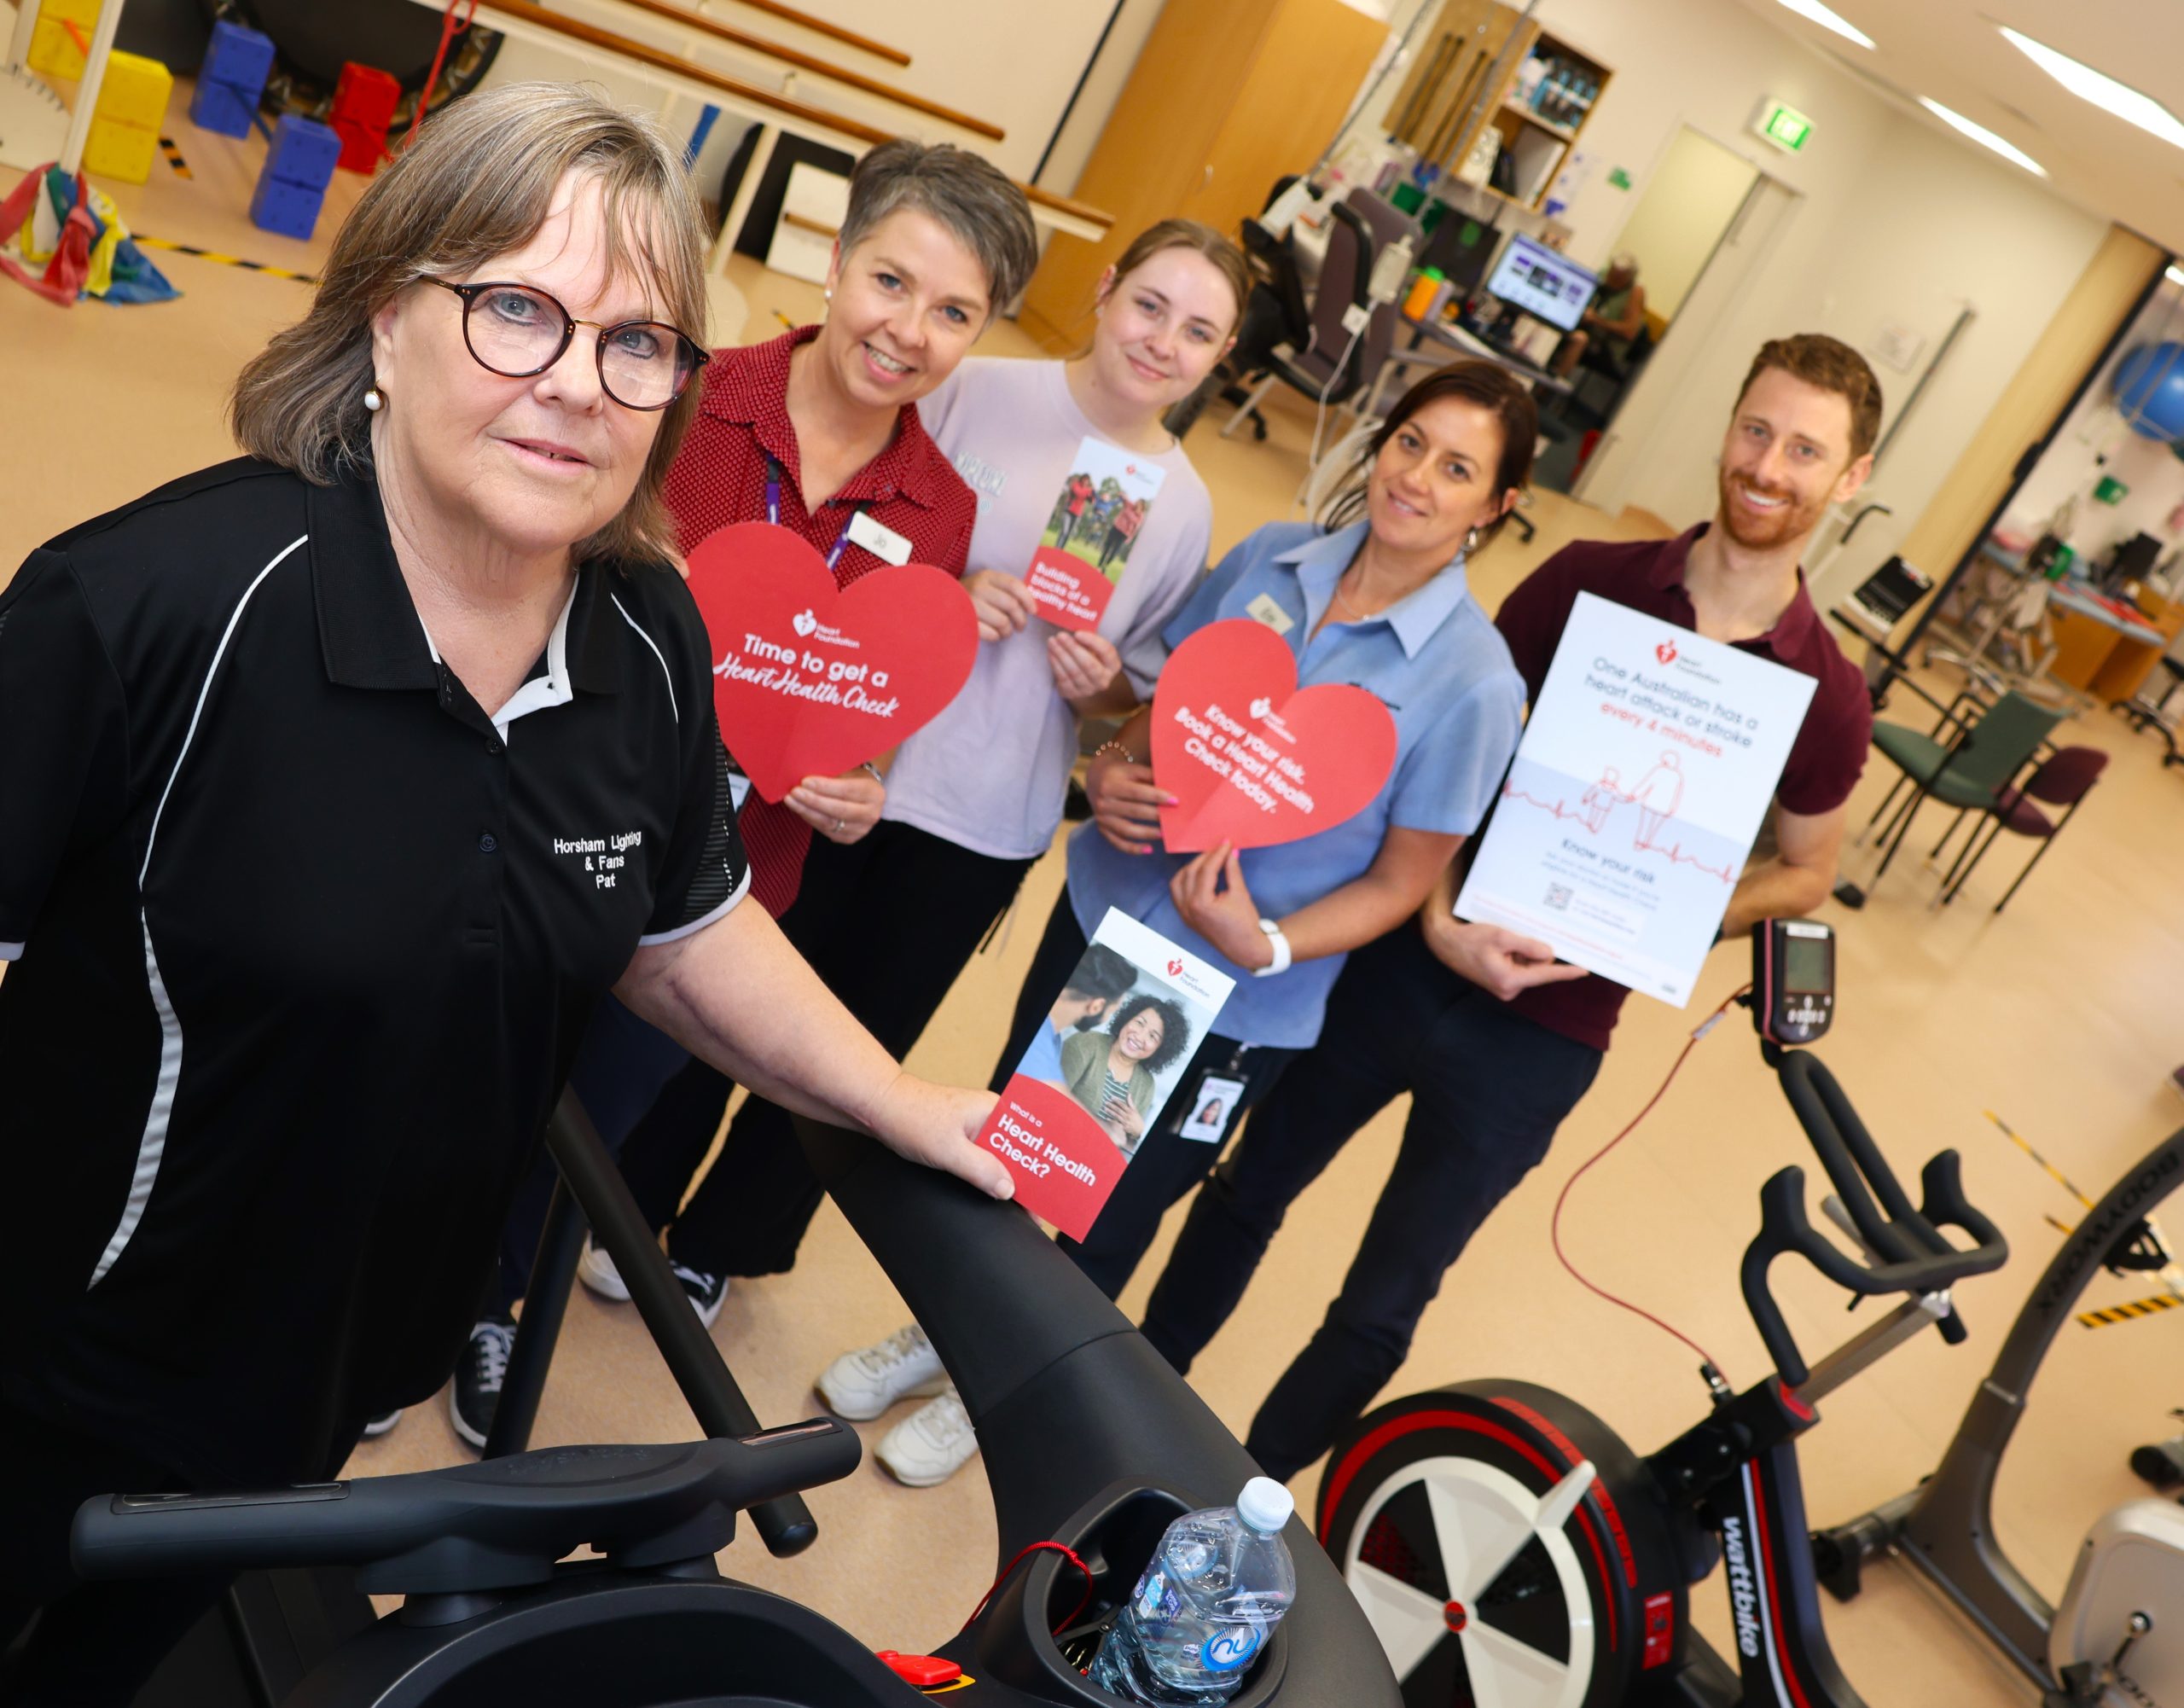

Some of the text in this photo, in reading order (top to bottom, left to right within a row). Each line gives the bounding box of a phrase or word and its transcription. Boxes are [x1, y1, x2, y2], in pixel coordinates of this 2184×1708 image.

[1036, 561, 1079, 590] Building
[713, 652, 900, 717] Heart Health Check
[745, 633, 889, 688] Time to get a
[1584, 672, 1753, 748] heart attack or stroke
[1593, 656, 1759, 730] One Australian has a
[1205, 704, 1247, 739] Know
[1242, 731, 1280, 763] your
[1275, 756, 1306, 785] risk.
[1600, 702, 1644, 729] every
[1660, 723, 1722, 758] minutes
[1174, 706, 1315, 814] Book a Heart Health
[1184, 736, 1278, 814] Check today.
[554, 830, 642, 854] Horsham Lighting
[584, 855, 624, 871] & Fans
[1561, 837, 1598, 860] Know
[1600, 851, 1630, 874] your
[1632, 867, 1656, 886] risk
[595, 873, 616, 889] Pat
[1009, 1101, 1030, 1119] What
[1028, 1114, 1036, 1124] is
[990, 1132, 1050, 1178] Check?
[997, 1113, 1096, 1187] Heart Health
[1723, 1516, 1760, 1658] wattbike
[1212, 1636, 1256, 1655] nu
